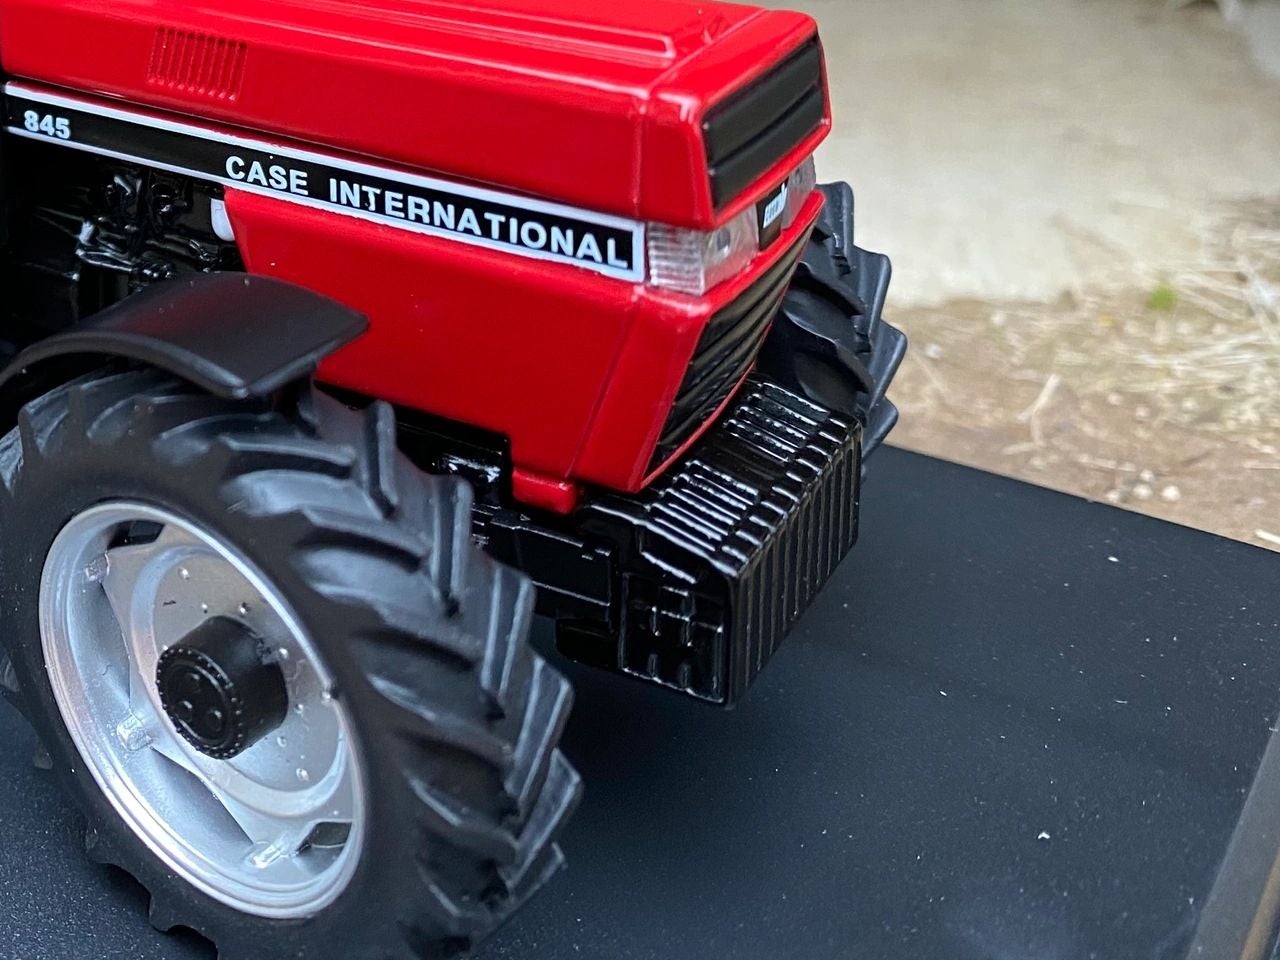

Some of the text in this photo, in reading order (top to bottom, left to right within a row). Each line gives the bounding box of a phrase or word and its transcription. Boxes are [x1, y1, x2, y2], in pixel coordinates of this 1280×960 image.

[23, 109, 71, 139] 845
[225, 155, 629, 269] CASE INTERNATIONAL
